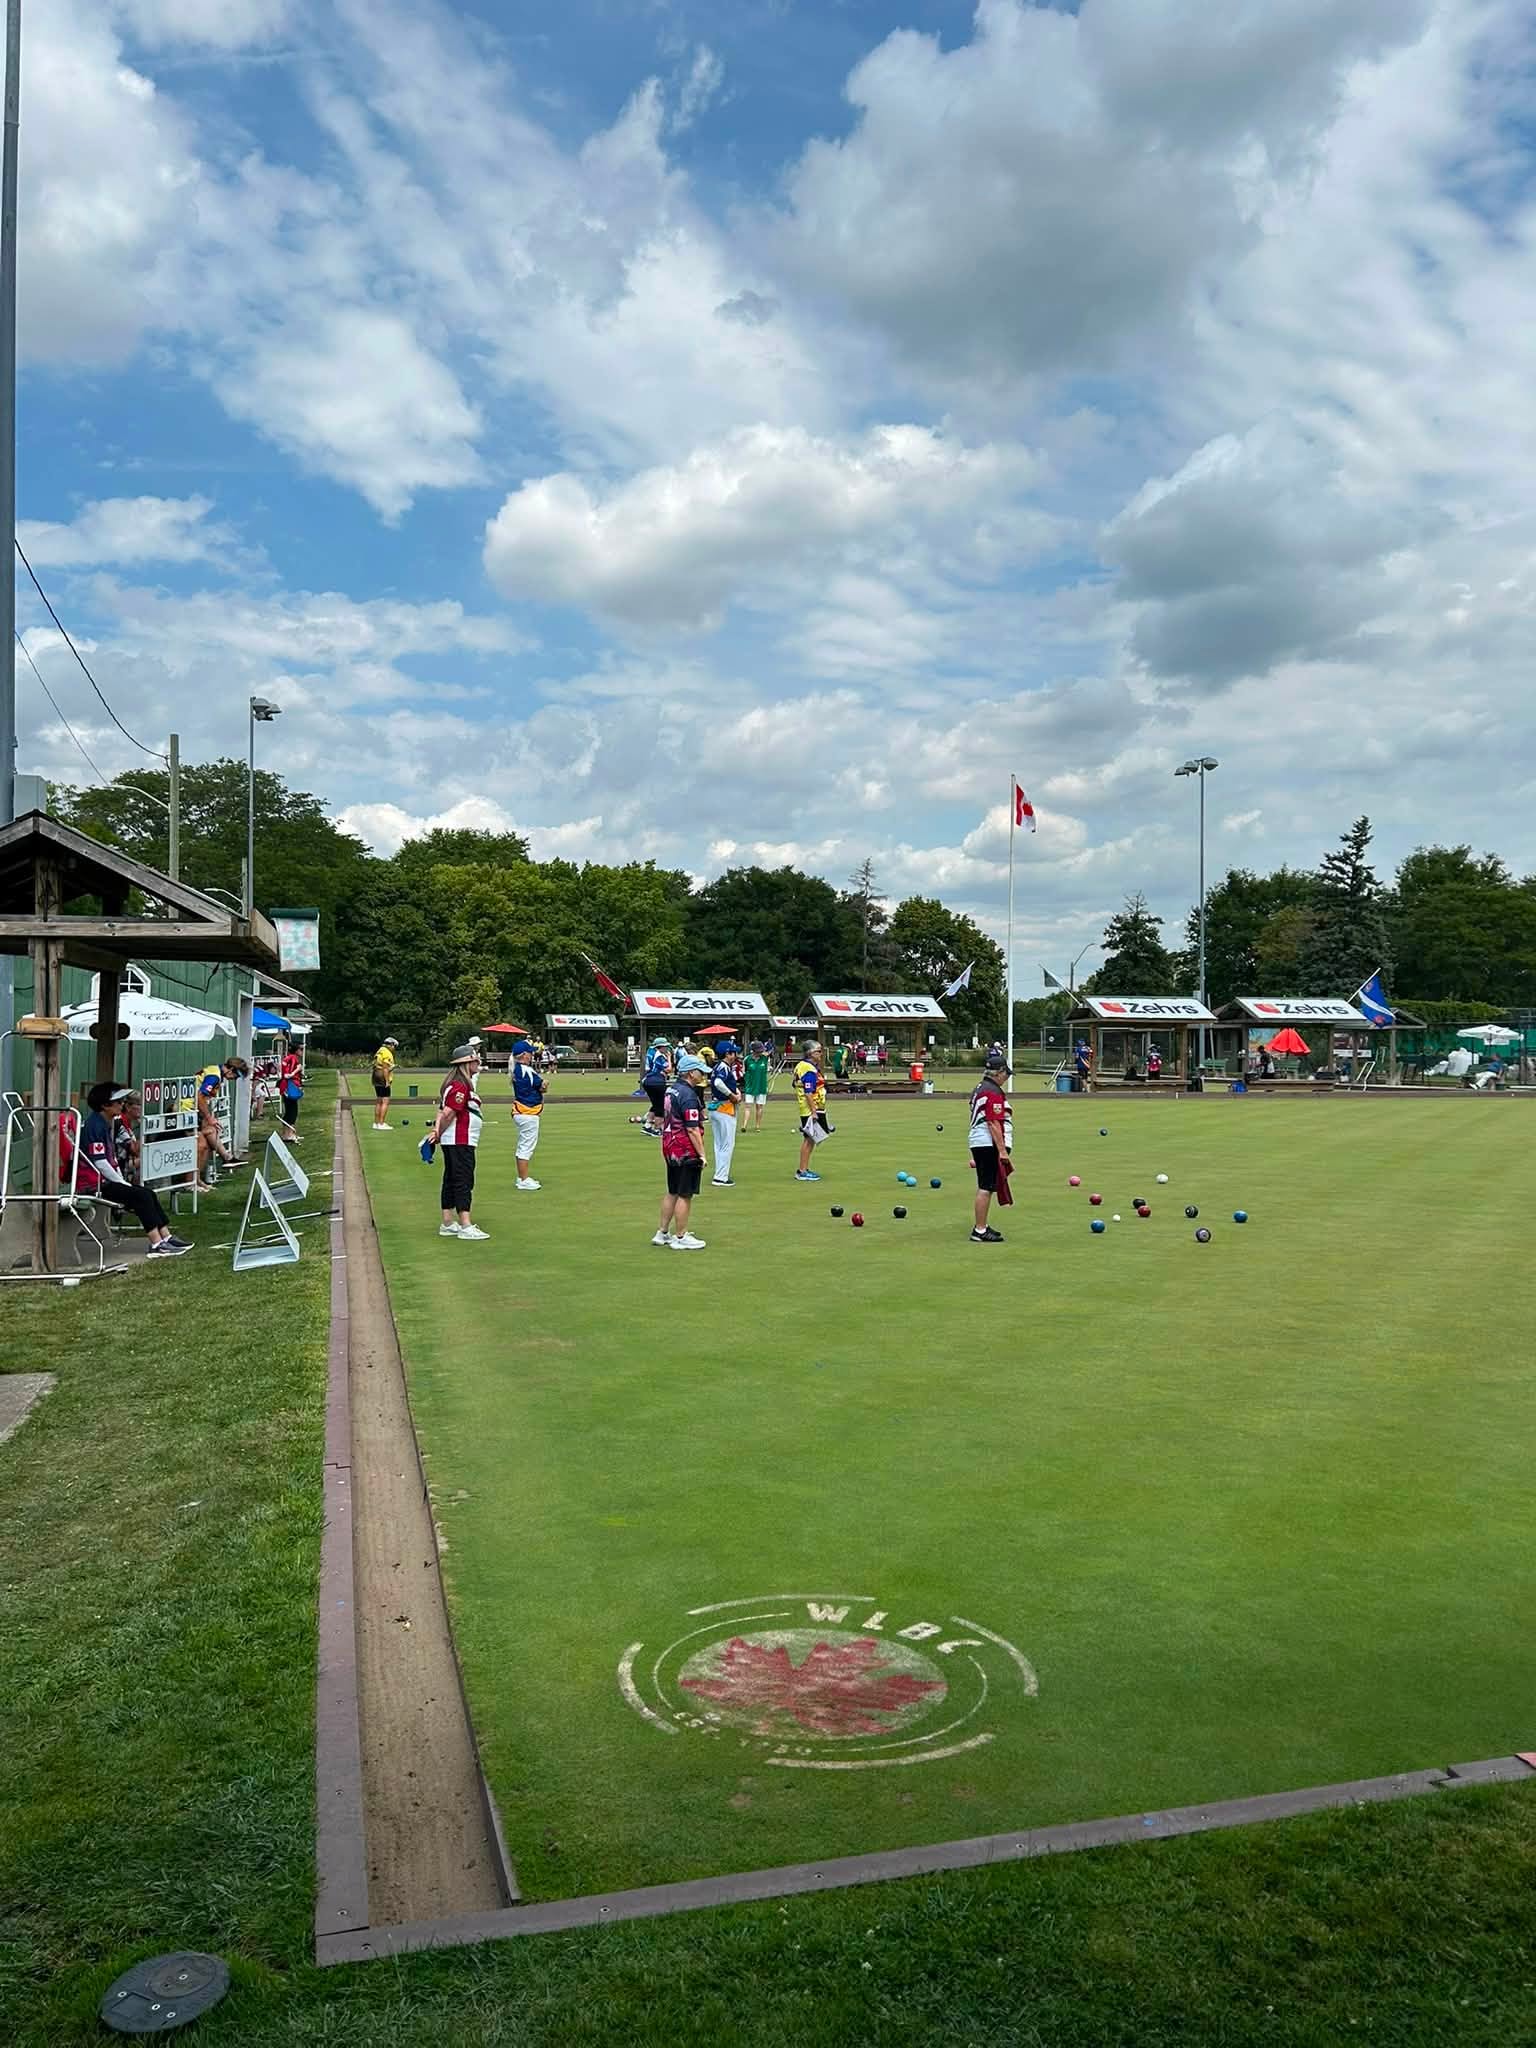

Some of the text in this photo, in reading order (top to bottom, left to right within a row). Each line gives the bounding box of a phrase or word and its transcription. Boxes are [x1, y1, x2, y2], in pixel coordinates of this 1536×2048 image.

[672, 996, 754, 1010] Zehrs
[851, 1000, 930, 1013] Zehrs
[1122, 1002, 1199, 1014] Zehrs
[1275, 1003, 1348, 1015] Zehrs
[567, 1017, 607, 1025] Zehrs
